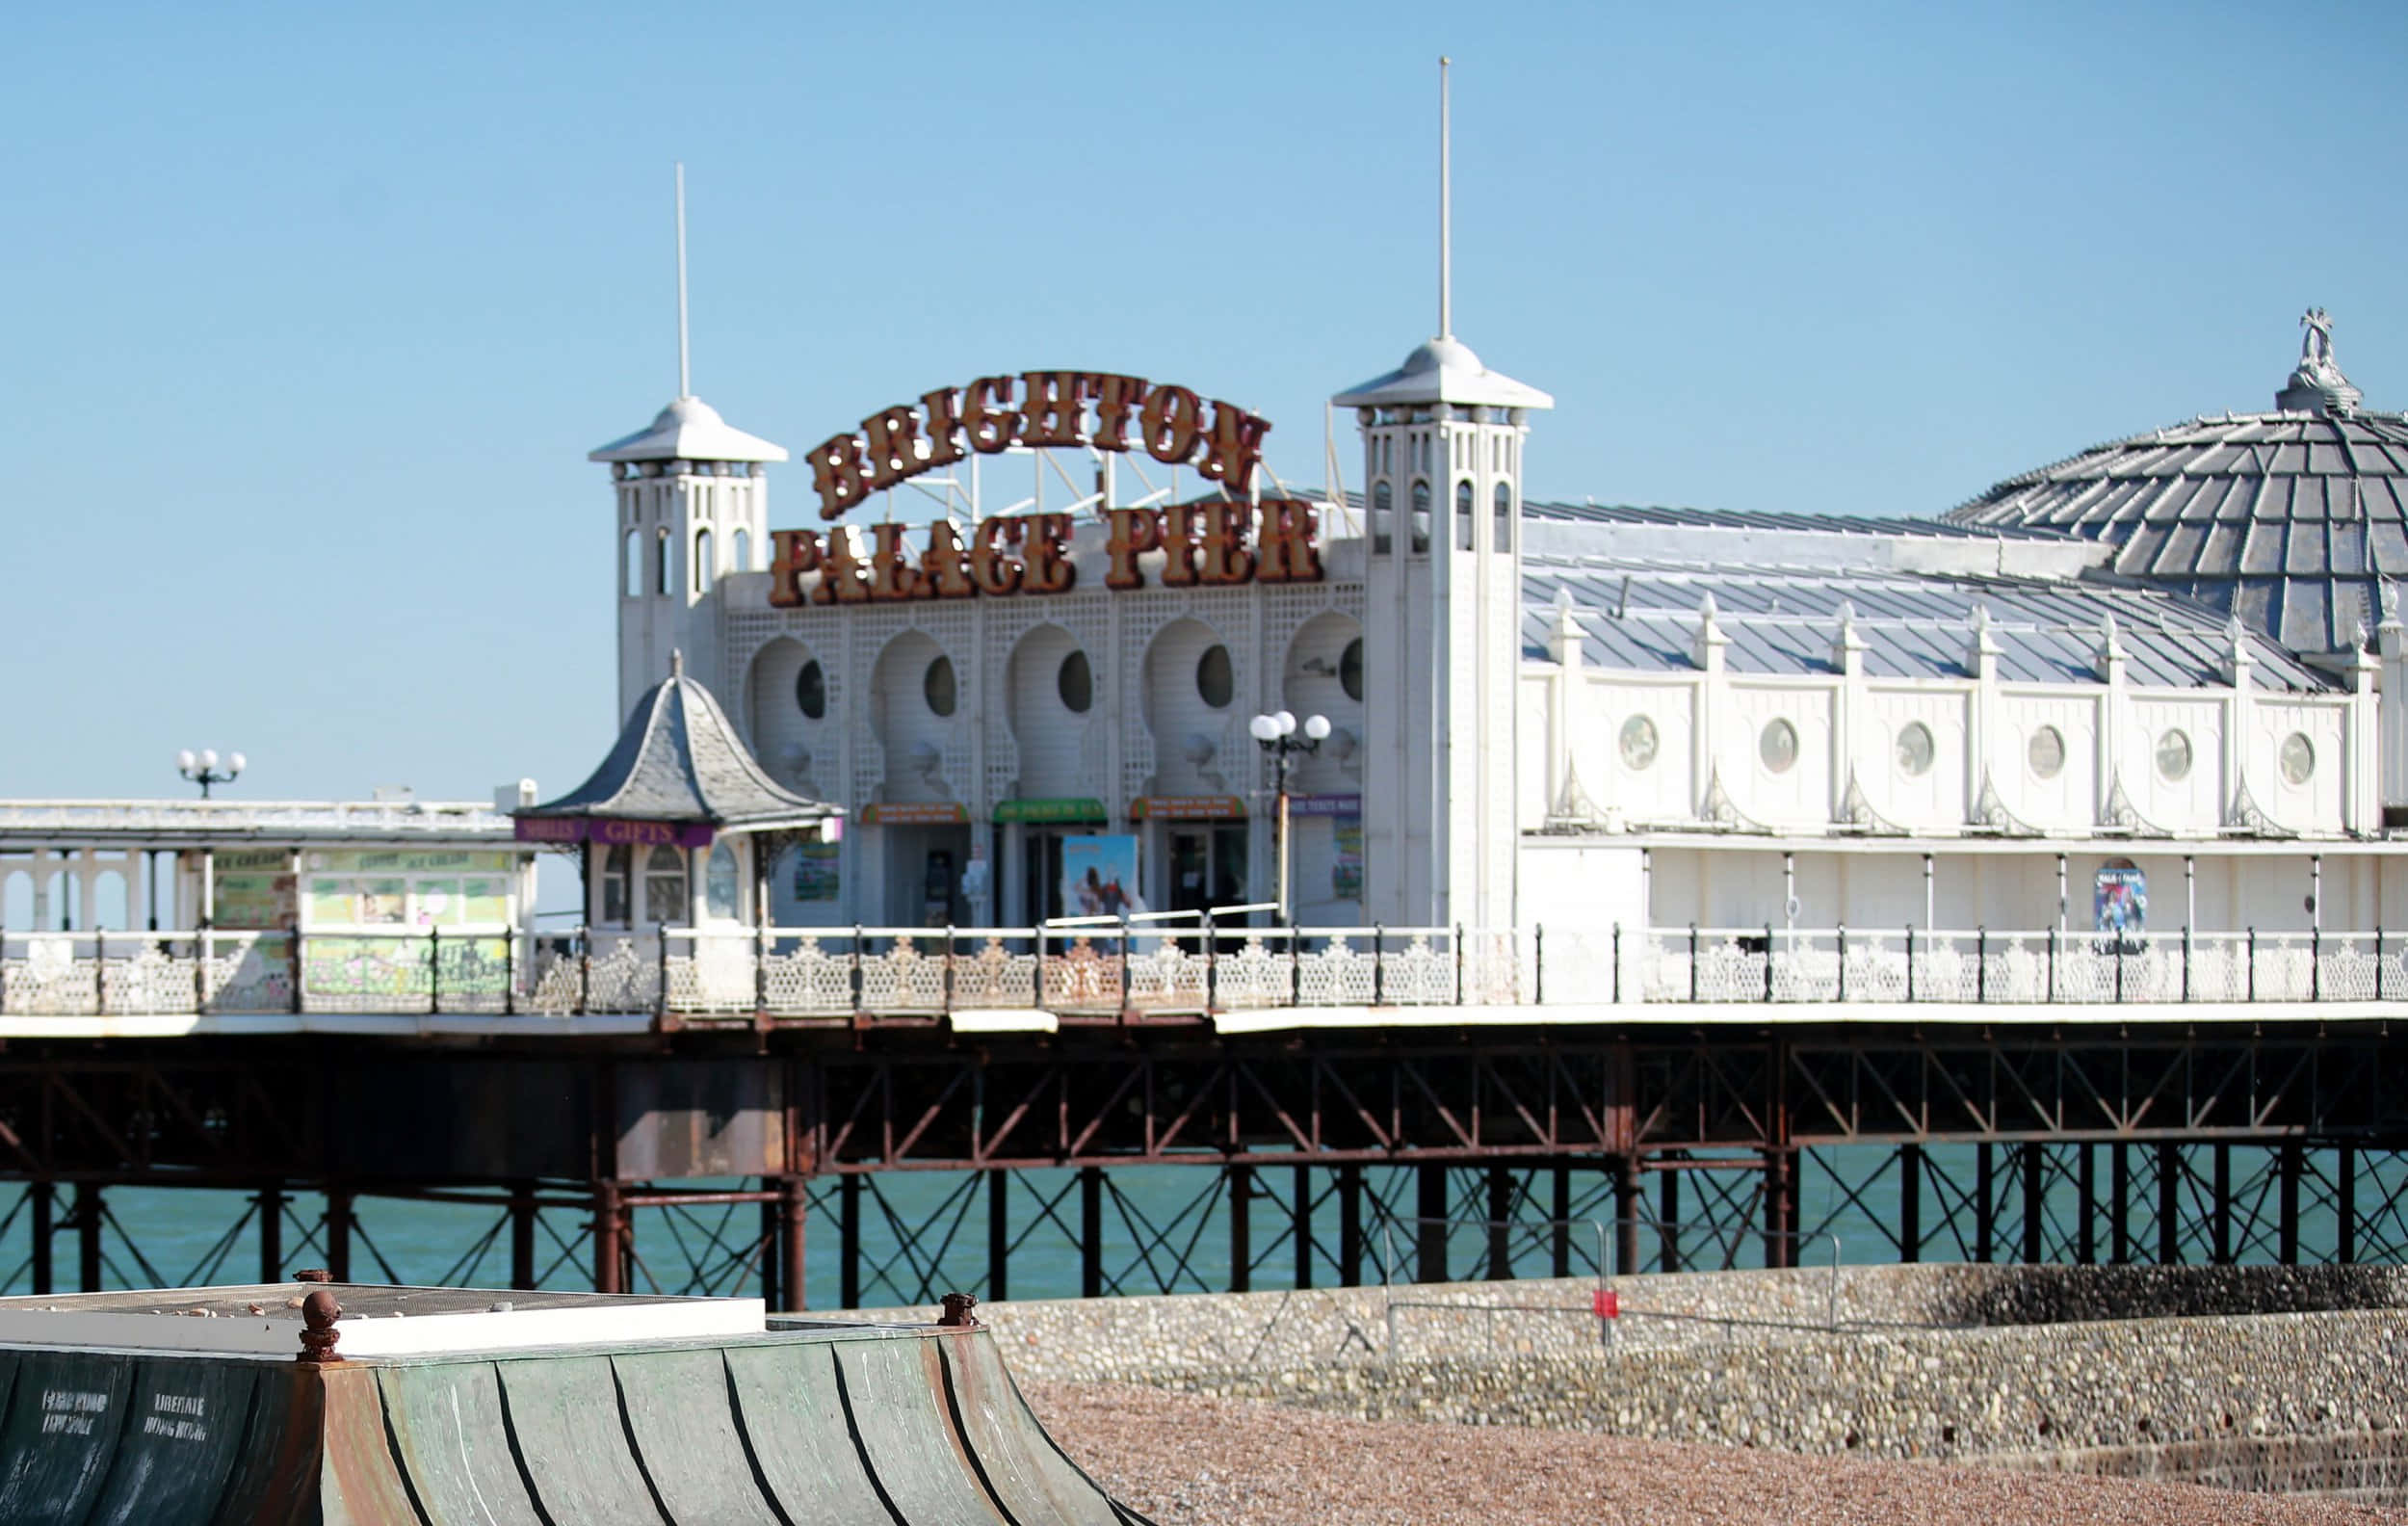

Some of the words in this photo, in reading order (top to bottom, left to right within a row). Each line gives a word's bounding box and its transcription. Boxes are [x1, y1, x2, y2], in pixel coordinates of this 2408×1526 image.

[805, 370, 1270, 520] BRIGHTON
[770, 513, 1076, 608] PALACE
[1105, 498, 1324, 590] PIER
[605, 820, 673, 843] GIFTS
[154, 1393, 205, 1417] LIBERATE
